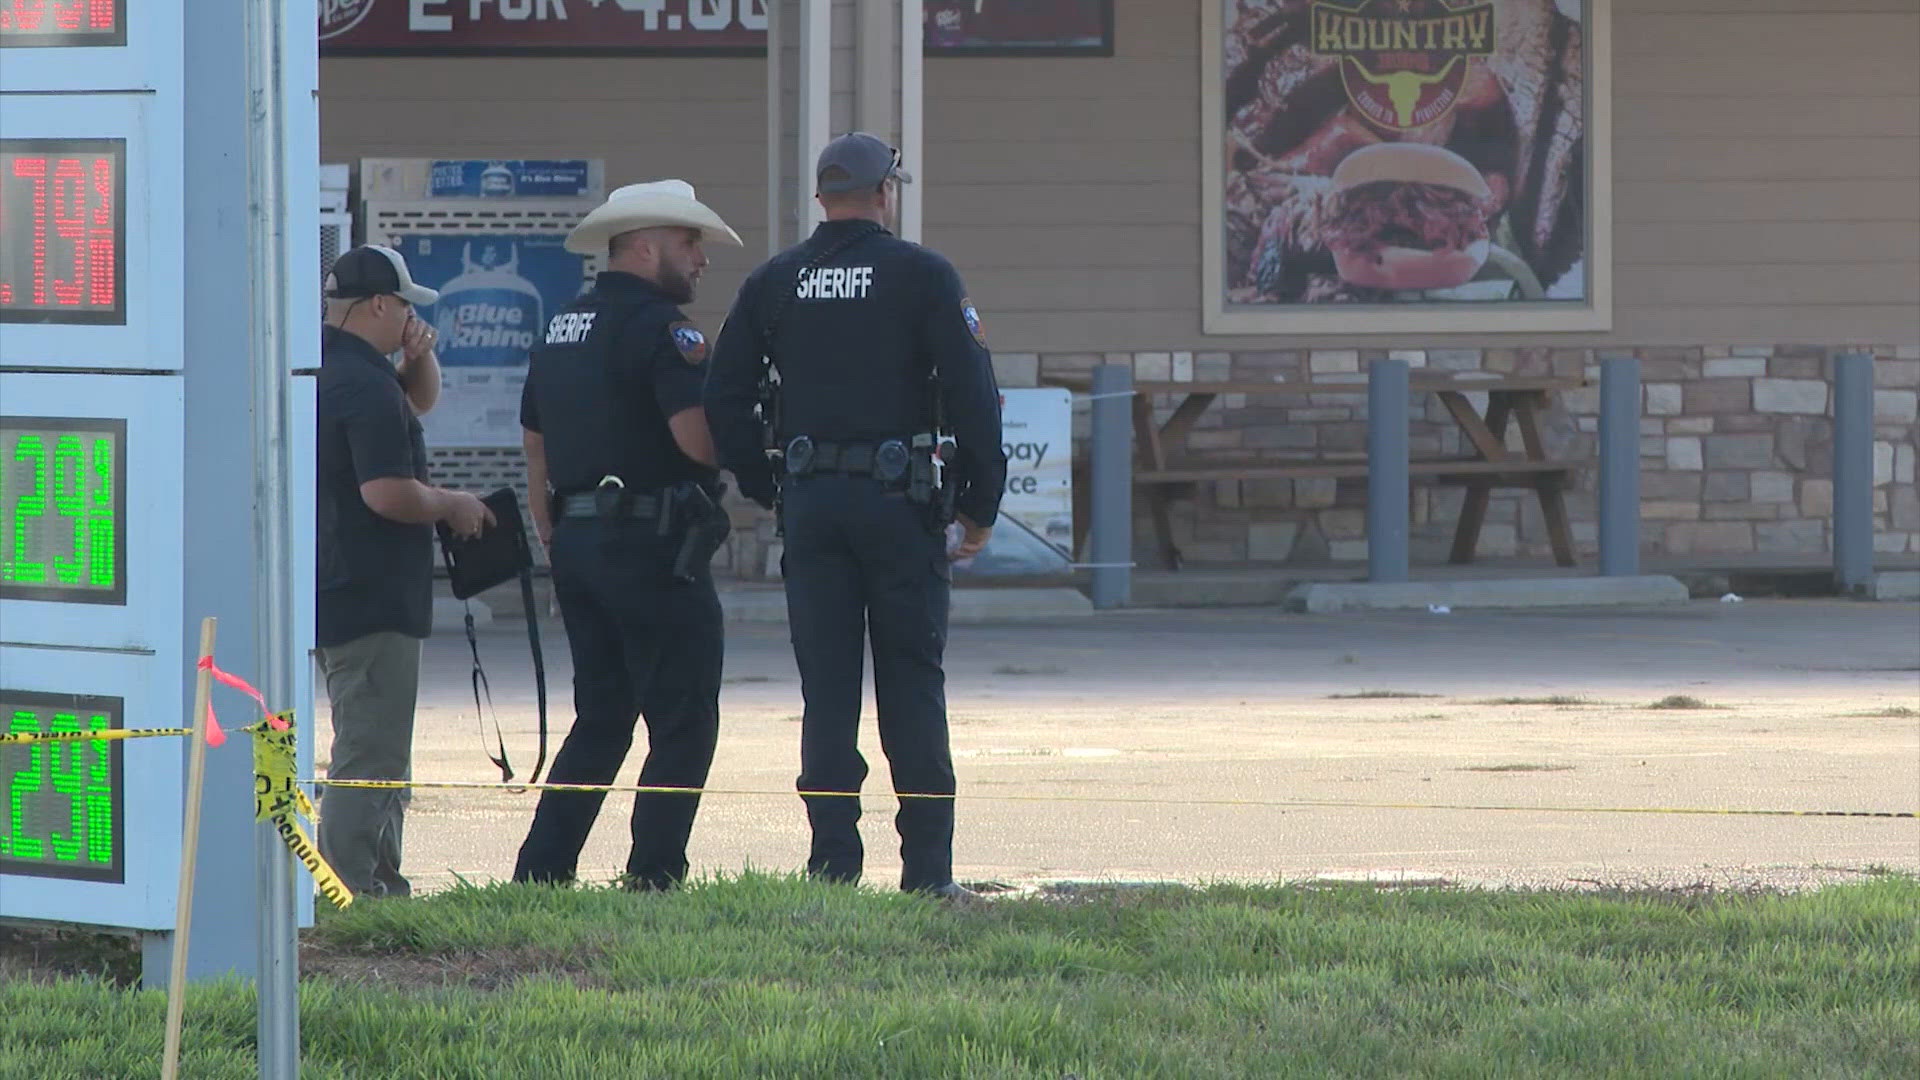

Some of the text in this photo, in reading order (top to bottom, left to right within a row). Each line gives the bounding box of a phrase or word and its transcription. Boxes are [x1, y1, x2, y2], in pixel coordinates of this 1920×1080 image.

[1319, 11, 1488, 49] KOUNTRY
[797, 266, 874, 299] SHERIFF
[458, 303, 523, 326] Blue
[545, 312, 597, 344] SHERIFF
[451, 324, 533, 349] Rhino
